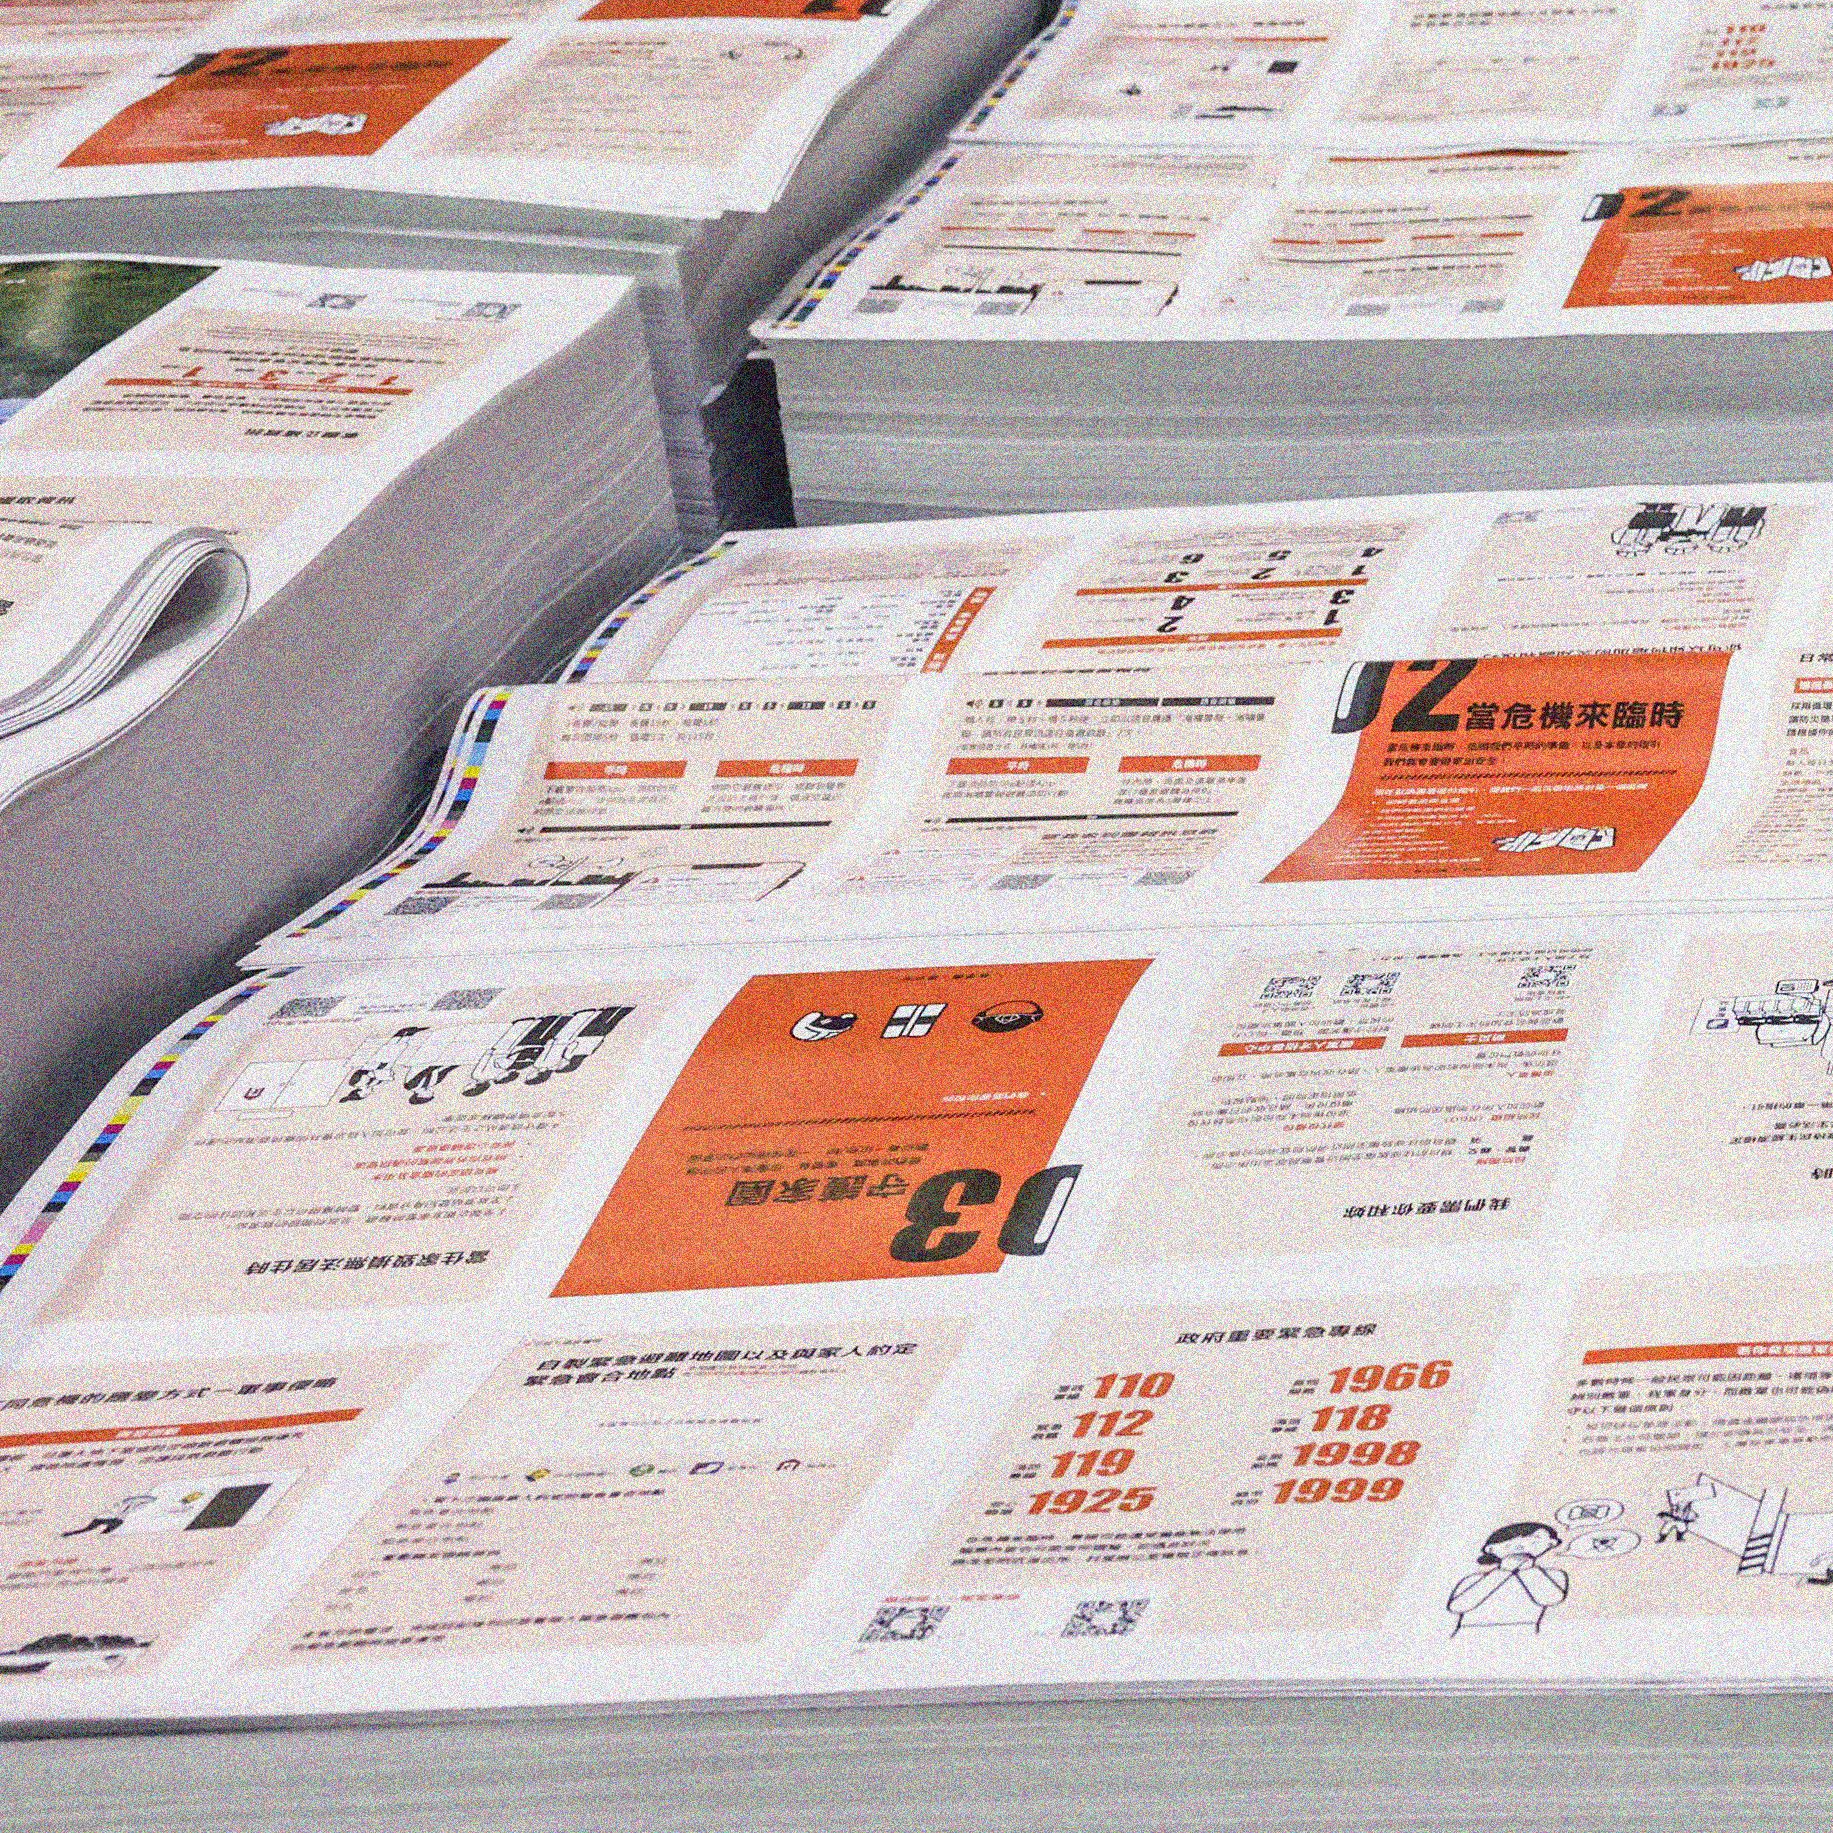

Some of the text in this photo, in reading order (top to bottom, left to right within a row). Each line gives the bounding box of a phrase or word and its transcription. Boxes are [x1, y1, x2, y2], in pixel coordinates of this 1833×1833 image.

[1466, 701, 1682, 730] 當危機來臨時
[727, 1173, 909, 1210] 守護家園
[890, 1164, 1083, 1263] 03
[1096, 1372, 1174, 1399] 110
[1332, 1360, 1452, 1393] 1966
[1075, 1410, 1153, 1438] 112
[1314, 1404, 1391, 1431] 118
[1053, 1448, 1134, 1478] 119
[1296, 1441, 1420, 1466] 1998
[1030, 1487, 1156, 1514] 1925
[1276, 1479, 1403, 1504] 1999
